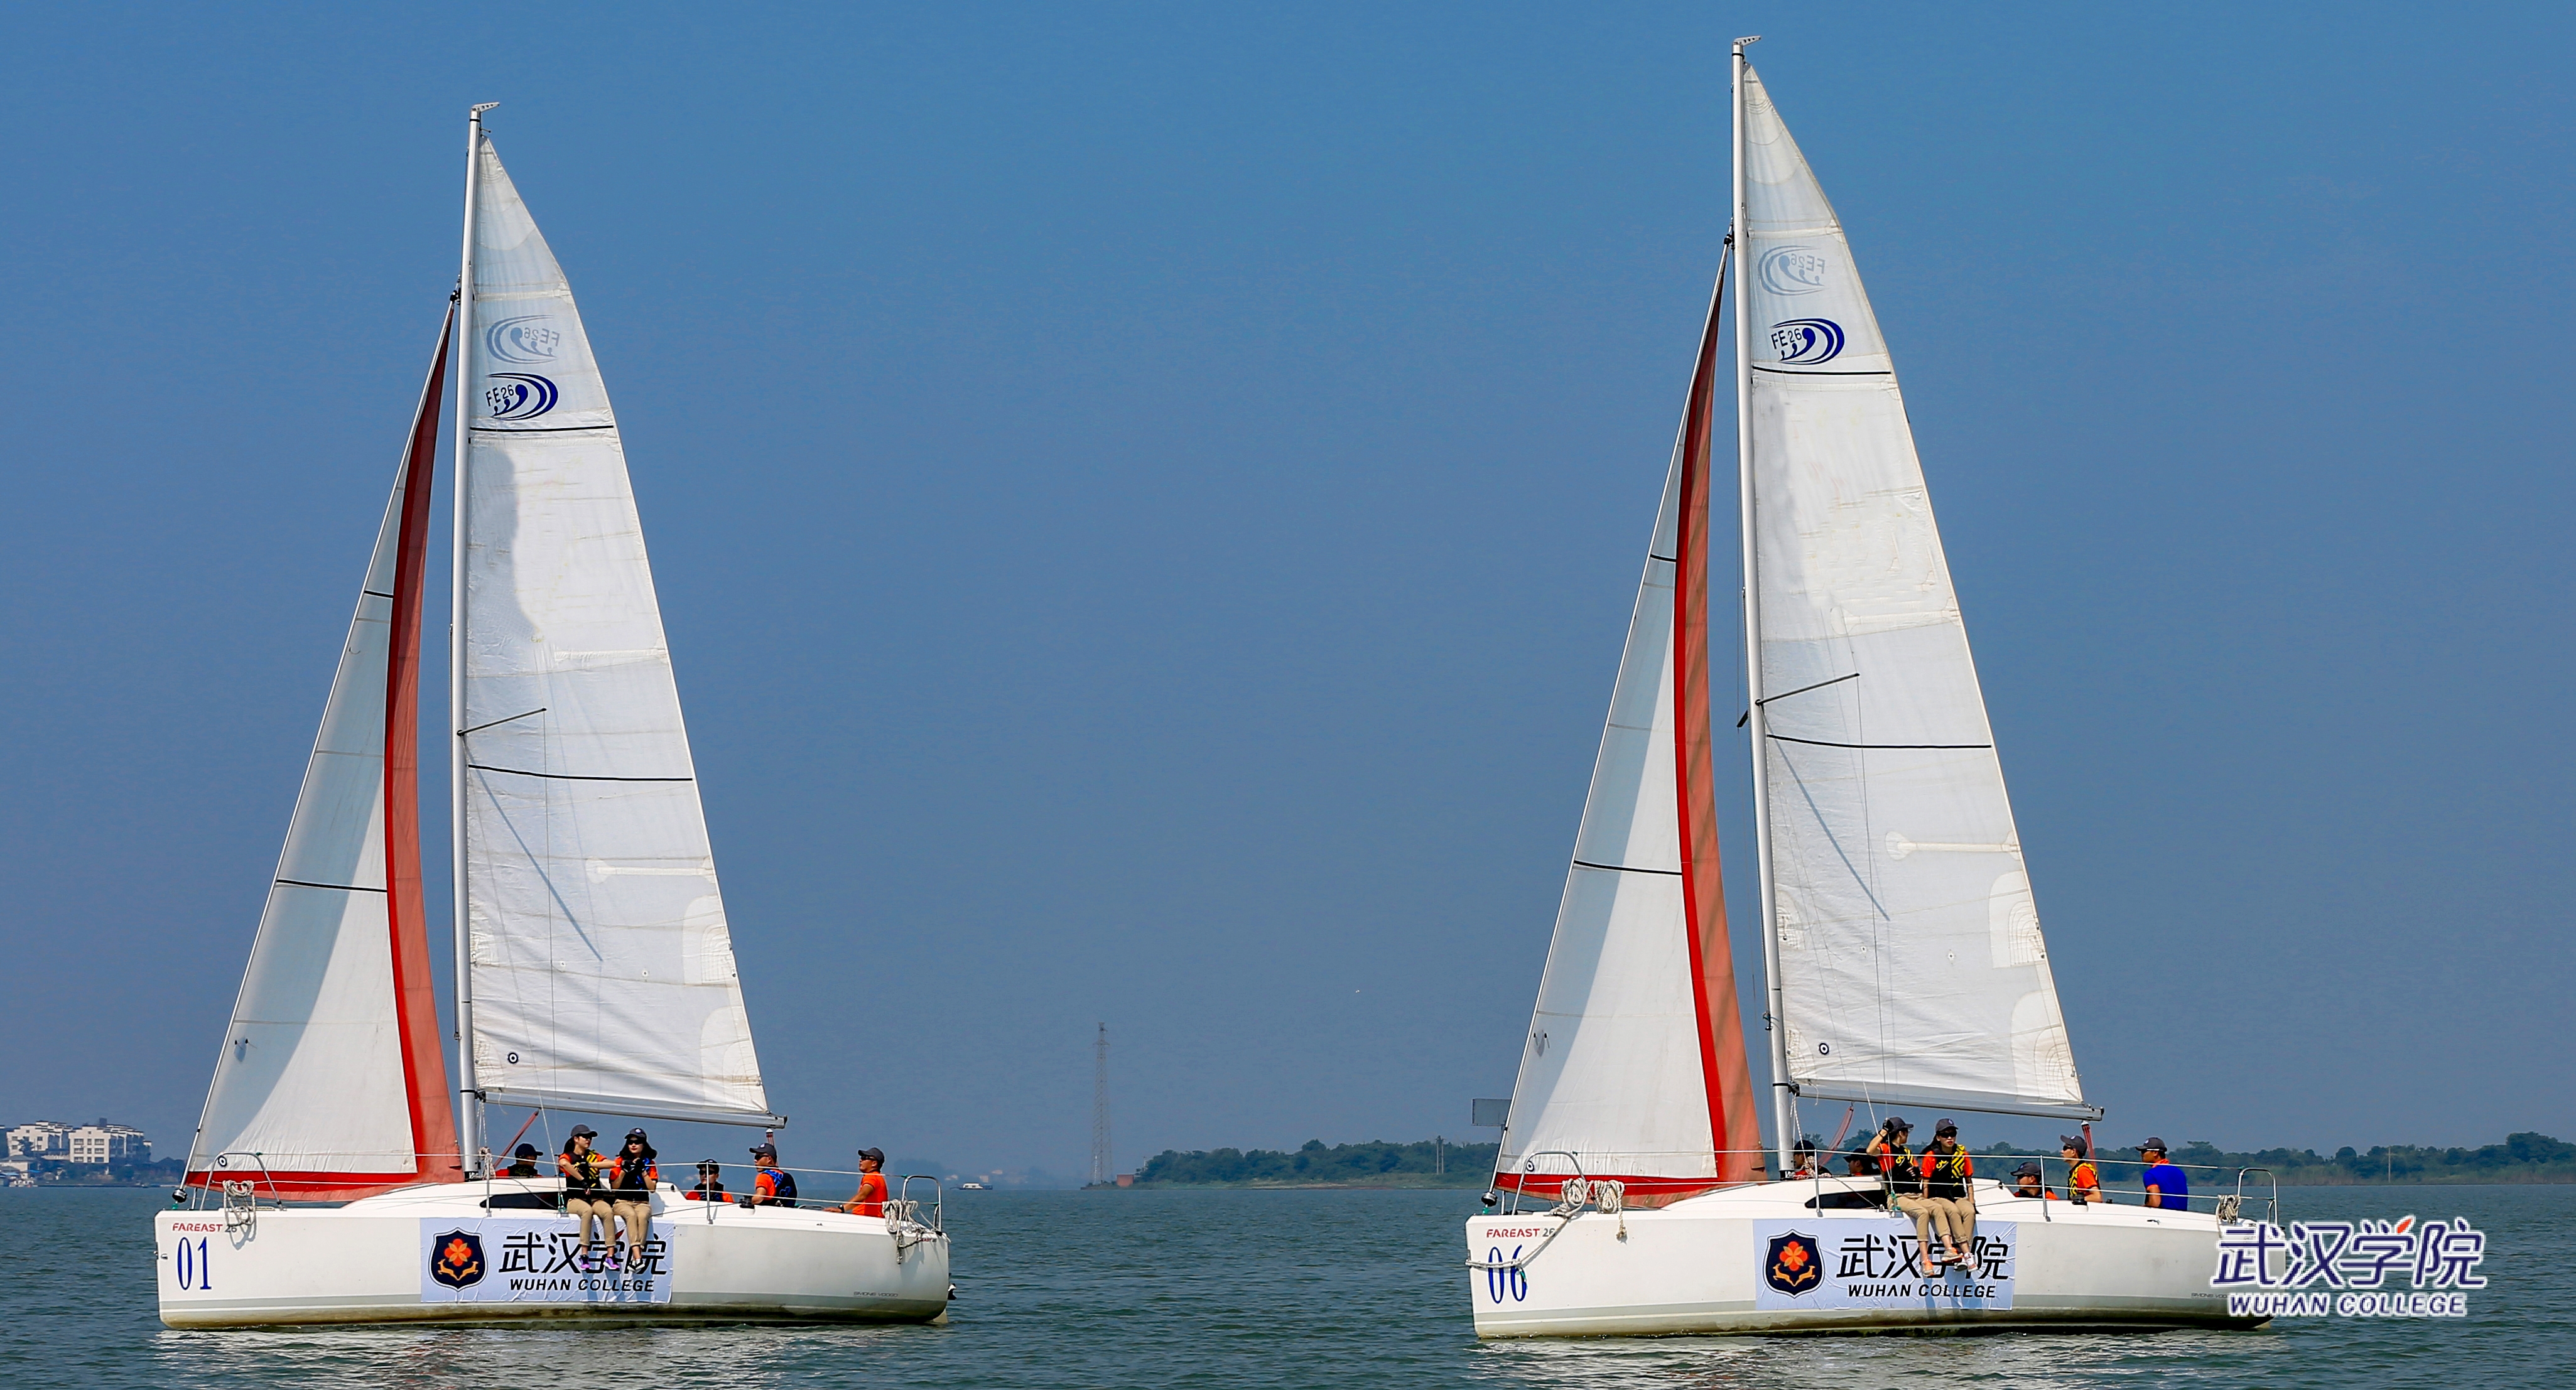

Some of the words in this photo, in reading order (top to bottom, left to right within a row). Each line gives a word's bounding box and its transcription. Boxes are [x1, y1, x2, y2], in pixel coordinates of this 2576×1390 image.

[1771, 328, 1802, 349] FE26
[485, 384, 514, 407] FE26
[172, 1223, 223, 1232] FAREAST
[1486, 1229, 1540, 1237] FAREAST
[177, 1236, 212, 1290] 01
[1488, 1244, 1527, 1304] 06
[510, 1279, 571, 1291] WUHAN
[578, 1279, 654, 1291] COLLEGE
[1848, 1284, 1910, 1297] WUHAN
[1918, 1284, 1996, 1298] COLLEGE
